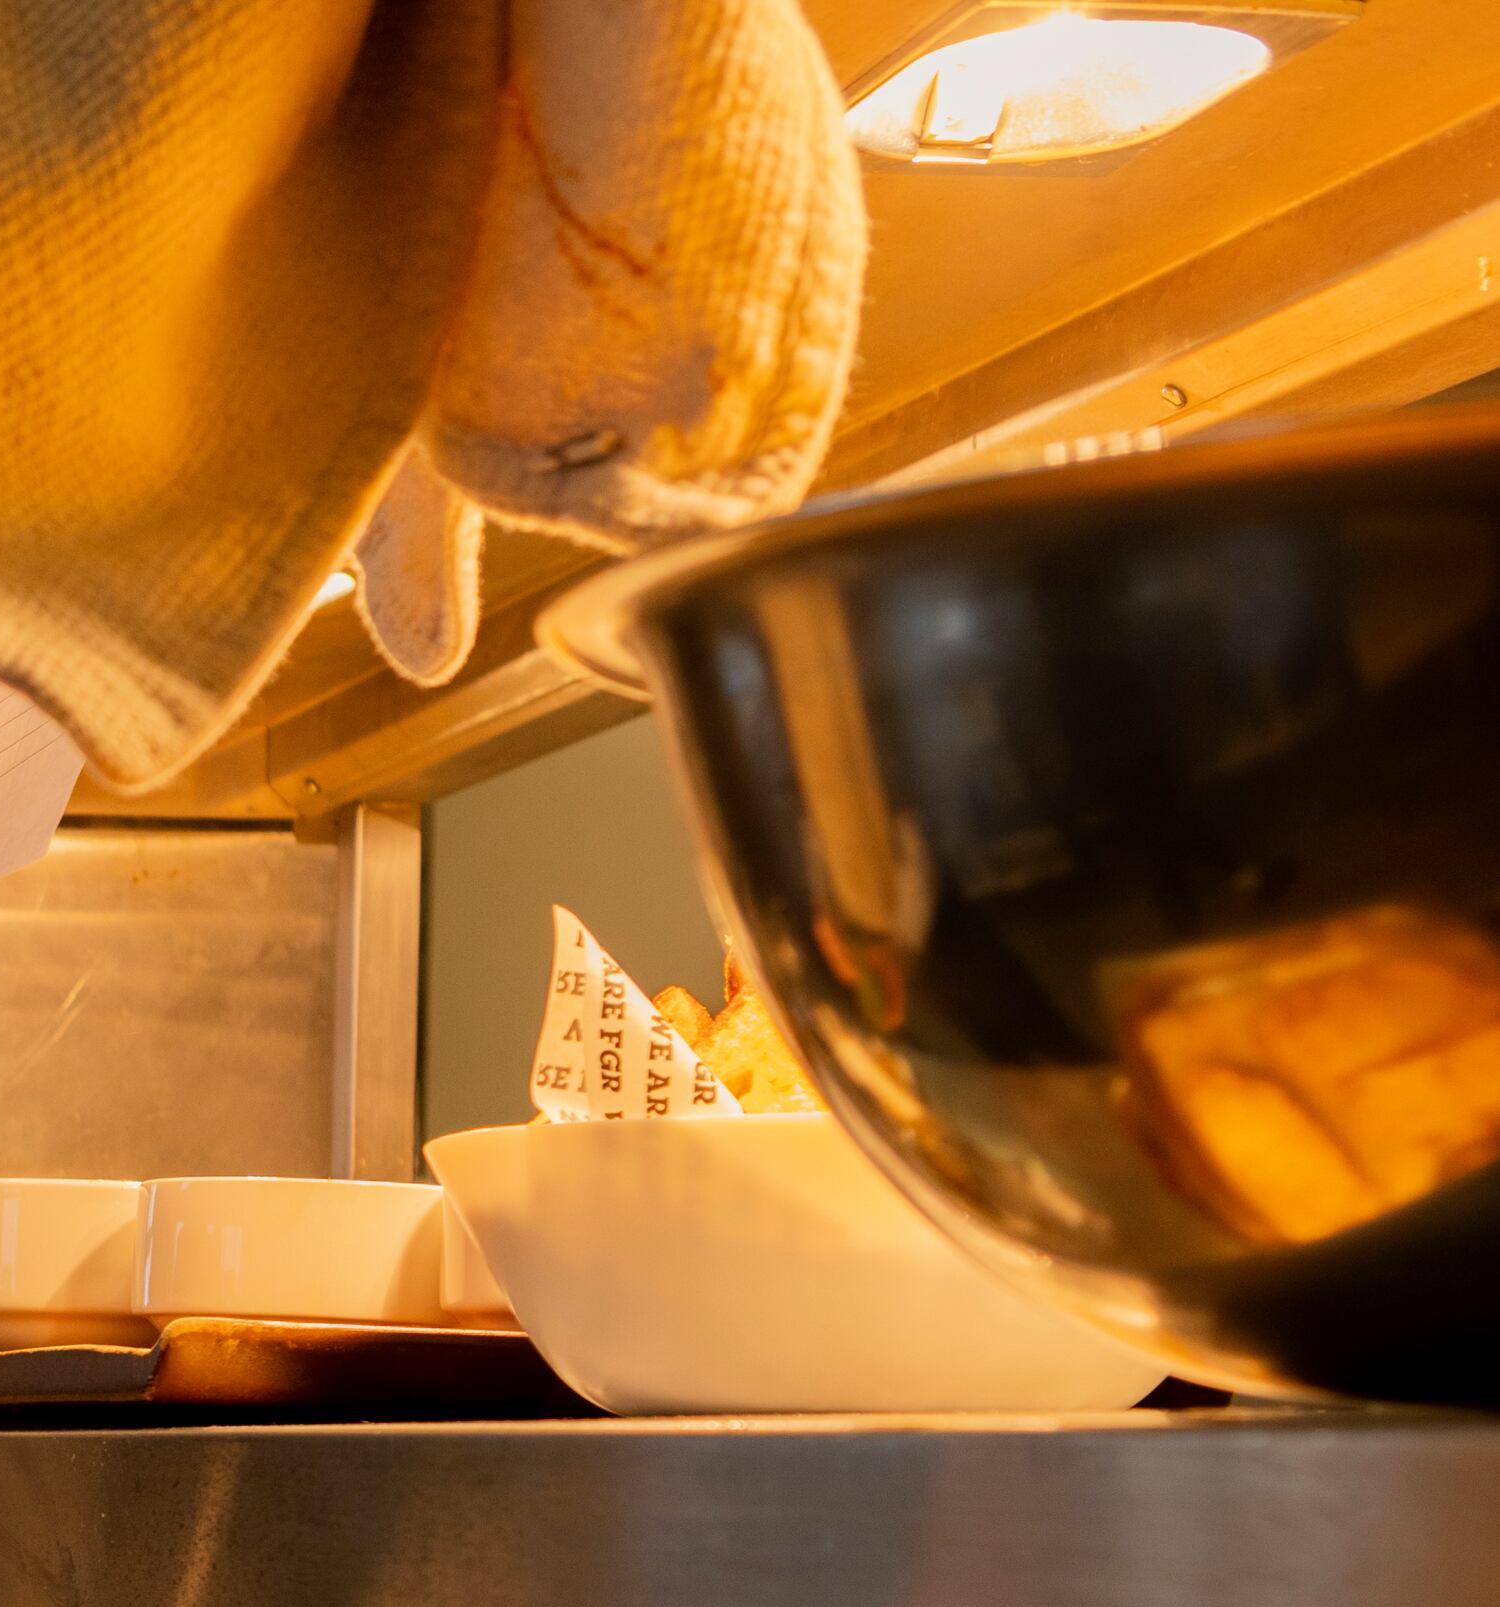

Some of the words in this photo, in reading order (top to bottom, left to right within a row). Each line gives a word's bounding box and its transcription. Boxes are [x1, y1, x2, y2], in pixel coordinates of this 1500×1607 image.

[602, 955, 627, 1020] ARE
[600, 1028, 622, 1093] FGR
[649, 1015, 673, 1061] WE
[646, 1070, 670, 1118] AR
